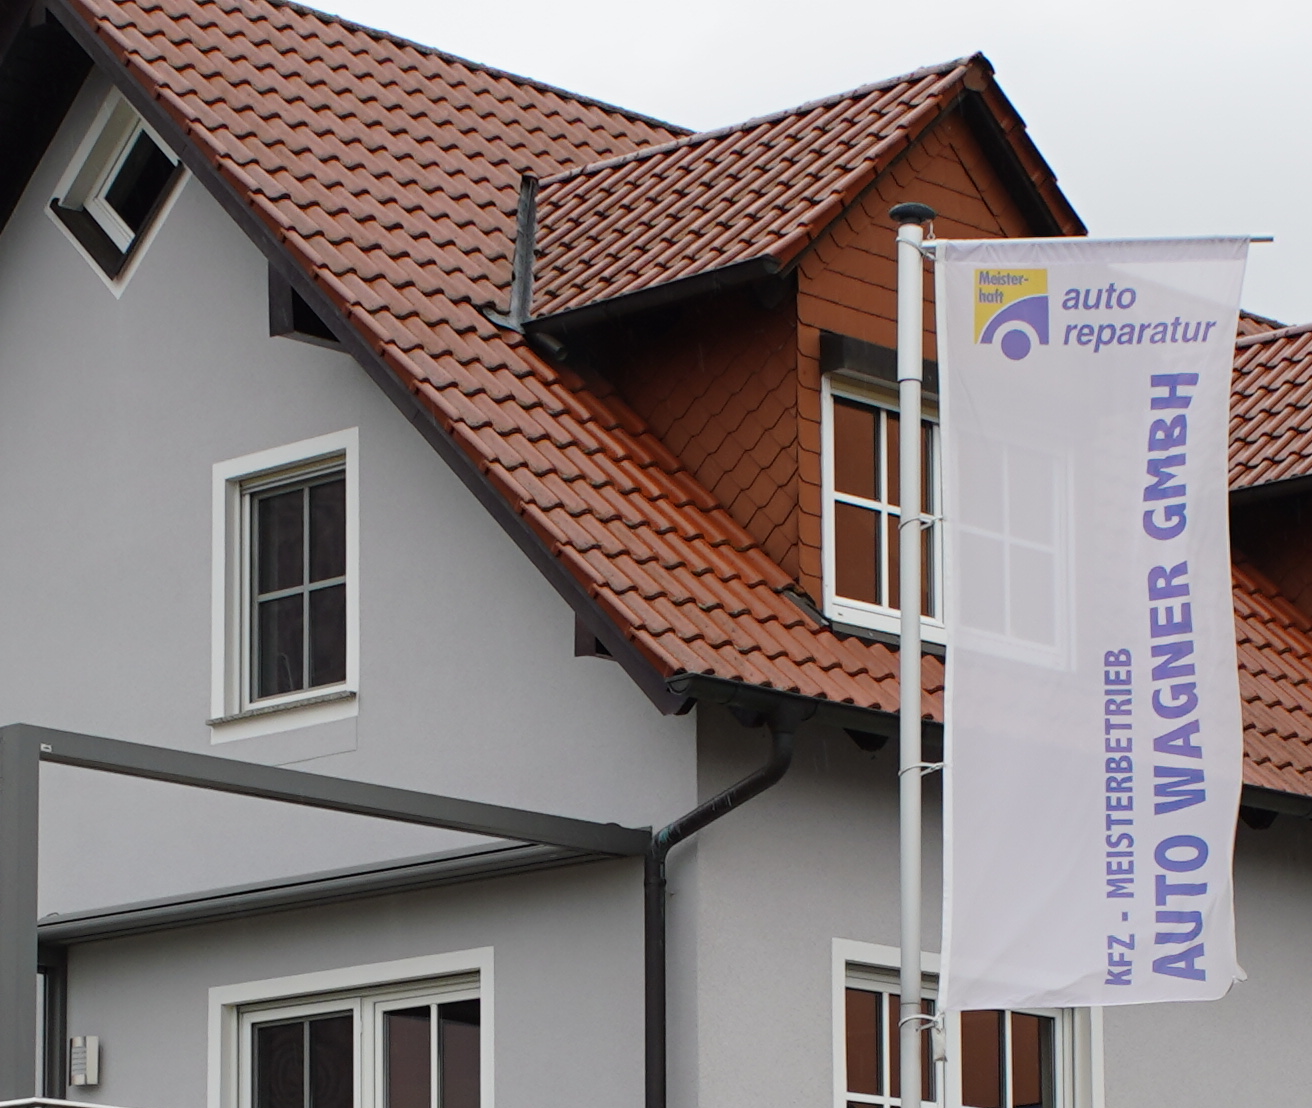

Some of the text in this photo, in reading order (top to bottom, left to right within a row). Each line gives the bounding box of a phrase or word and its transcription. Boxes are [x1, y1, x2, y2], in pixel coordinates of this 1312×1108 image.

[979, 271, 1029, 286] Meister-
[979, 289, 1004, 304] haft
[1062, 283, 1137, 310] auto
[1063, 317, 1217, 353] reparatur
[1142, 372, 1208, 981] AUTO WAGNER GMBH
[1104, 647, 1136, 900] MEISTERBETRIEB
[1104, 933, 1134, 986] KFZ
